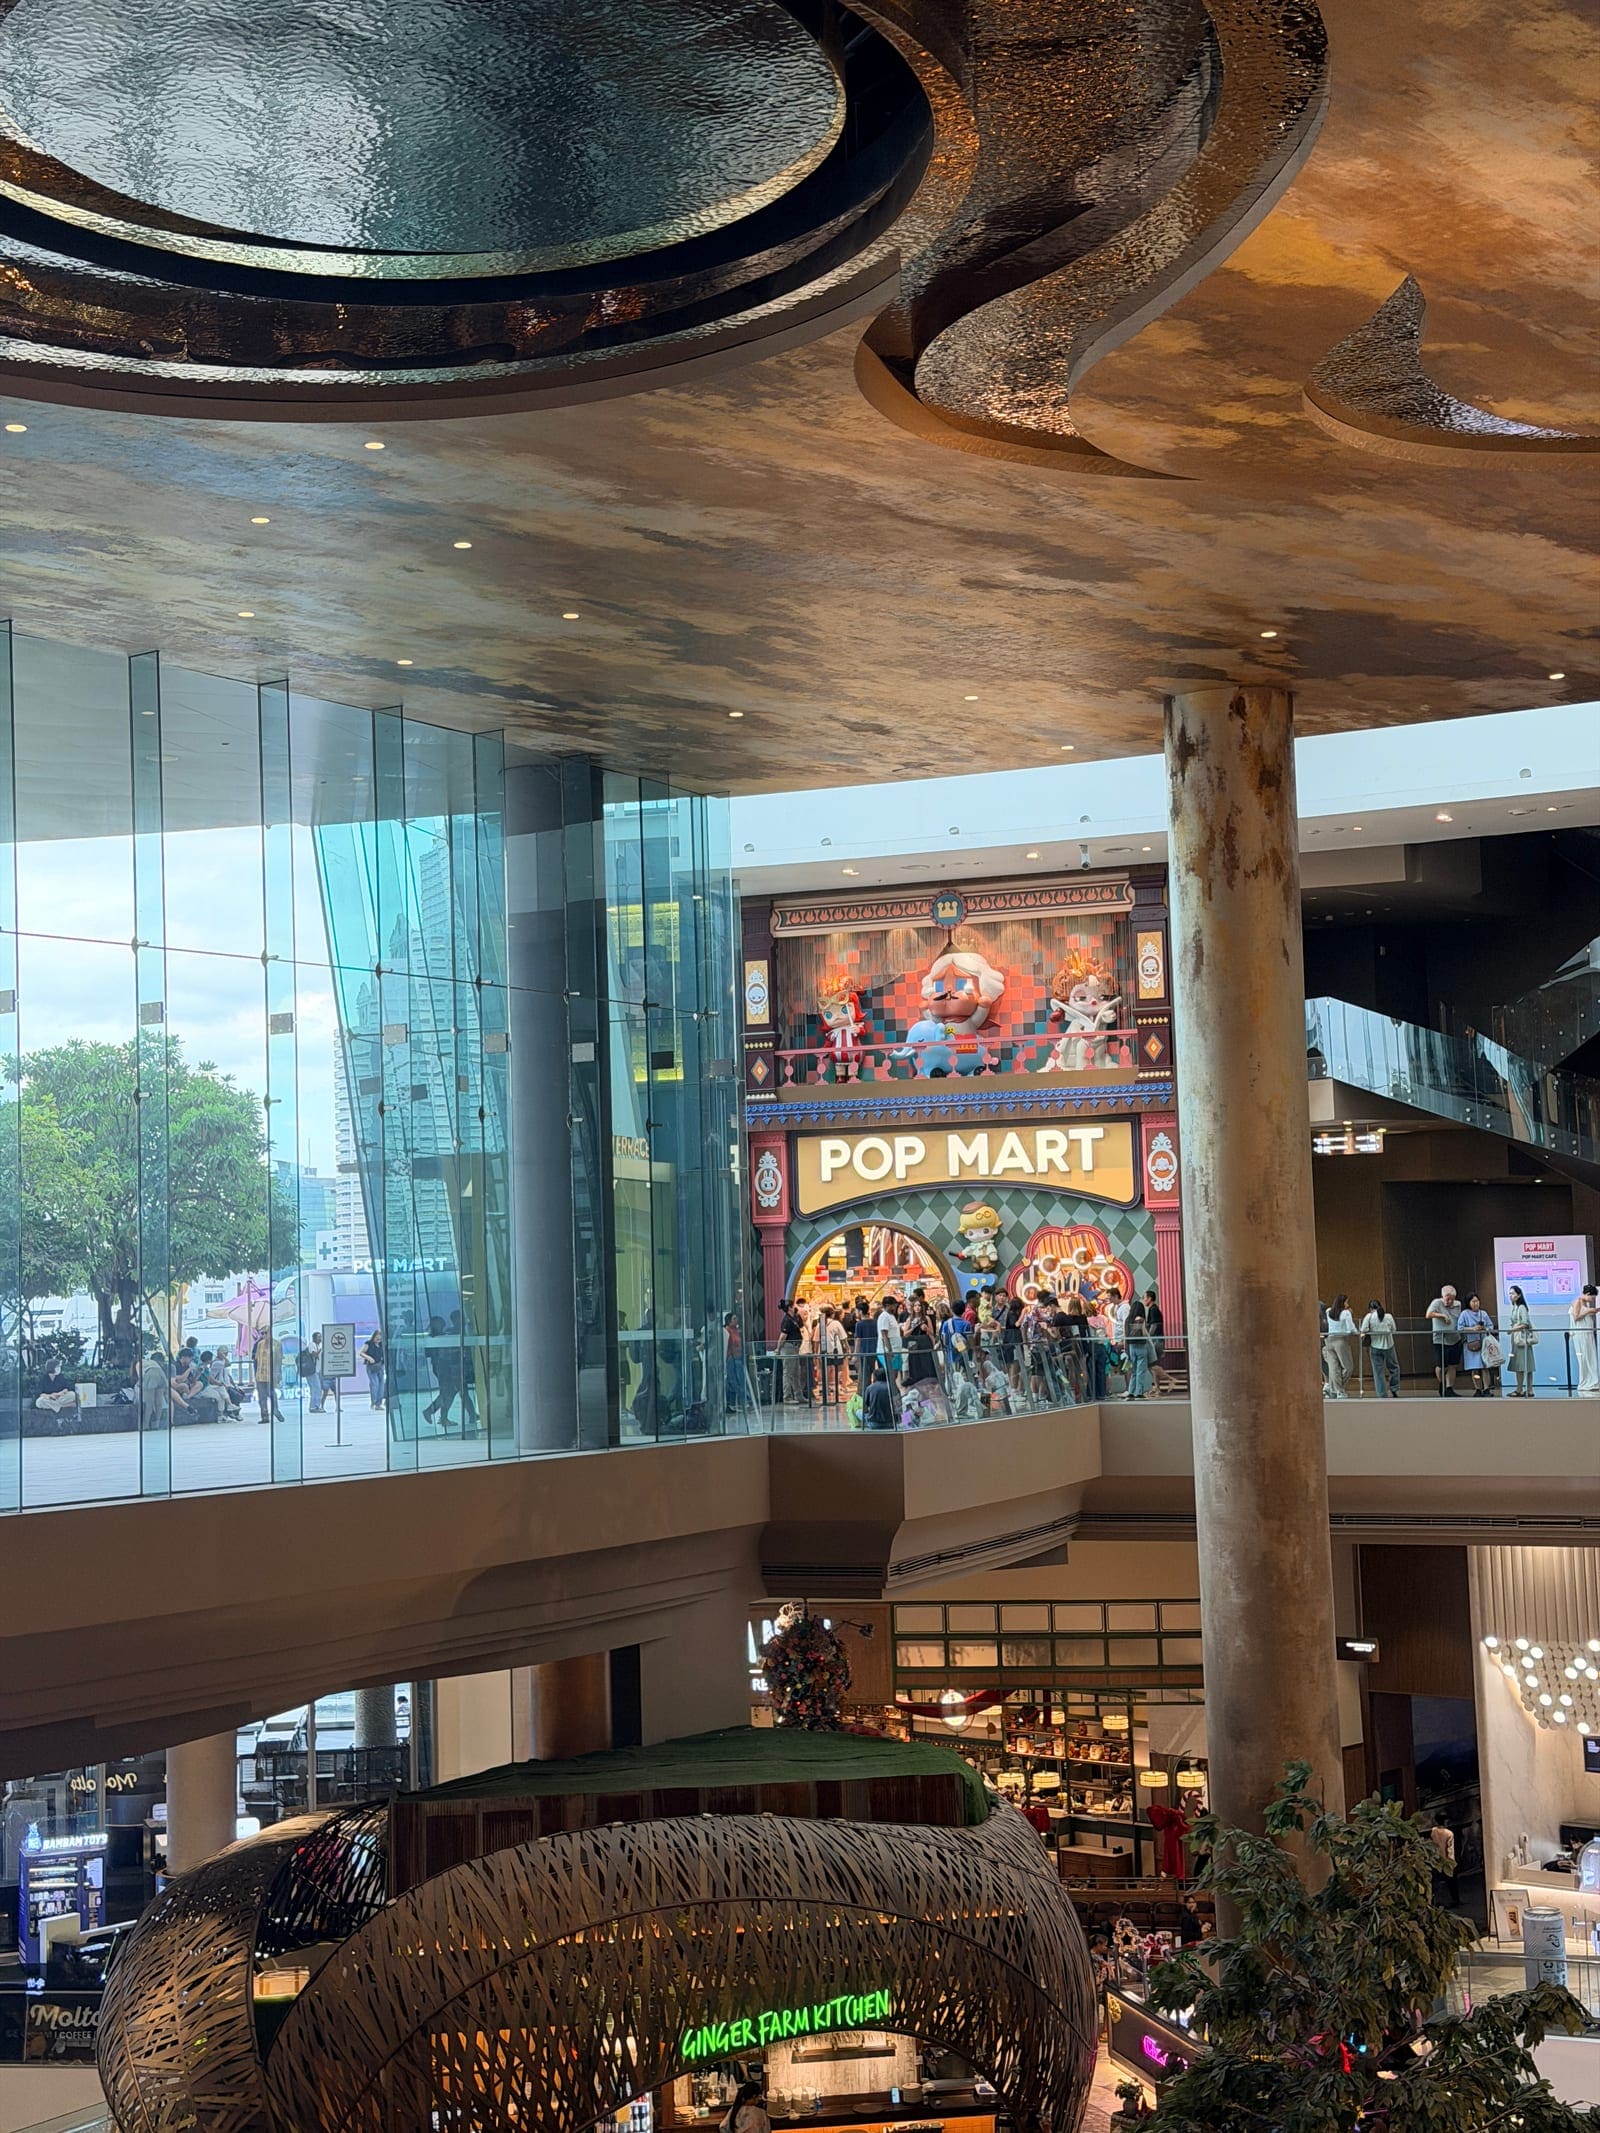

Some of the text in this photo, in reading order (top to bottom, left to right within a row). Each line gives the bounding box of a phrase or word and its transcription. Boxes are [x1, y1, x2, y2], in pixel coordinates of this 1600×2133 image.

[820, 1127, 1104, 1182] POP MART
[42, 1833, 109, 1850] BAMBAM TOYS
[59, 2031, 92, 2039] COFFEE
[683, 1989, 889, 2059] GINGER FARM KITCHEN
